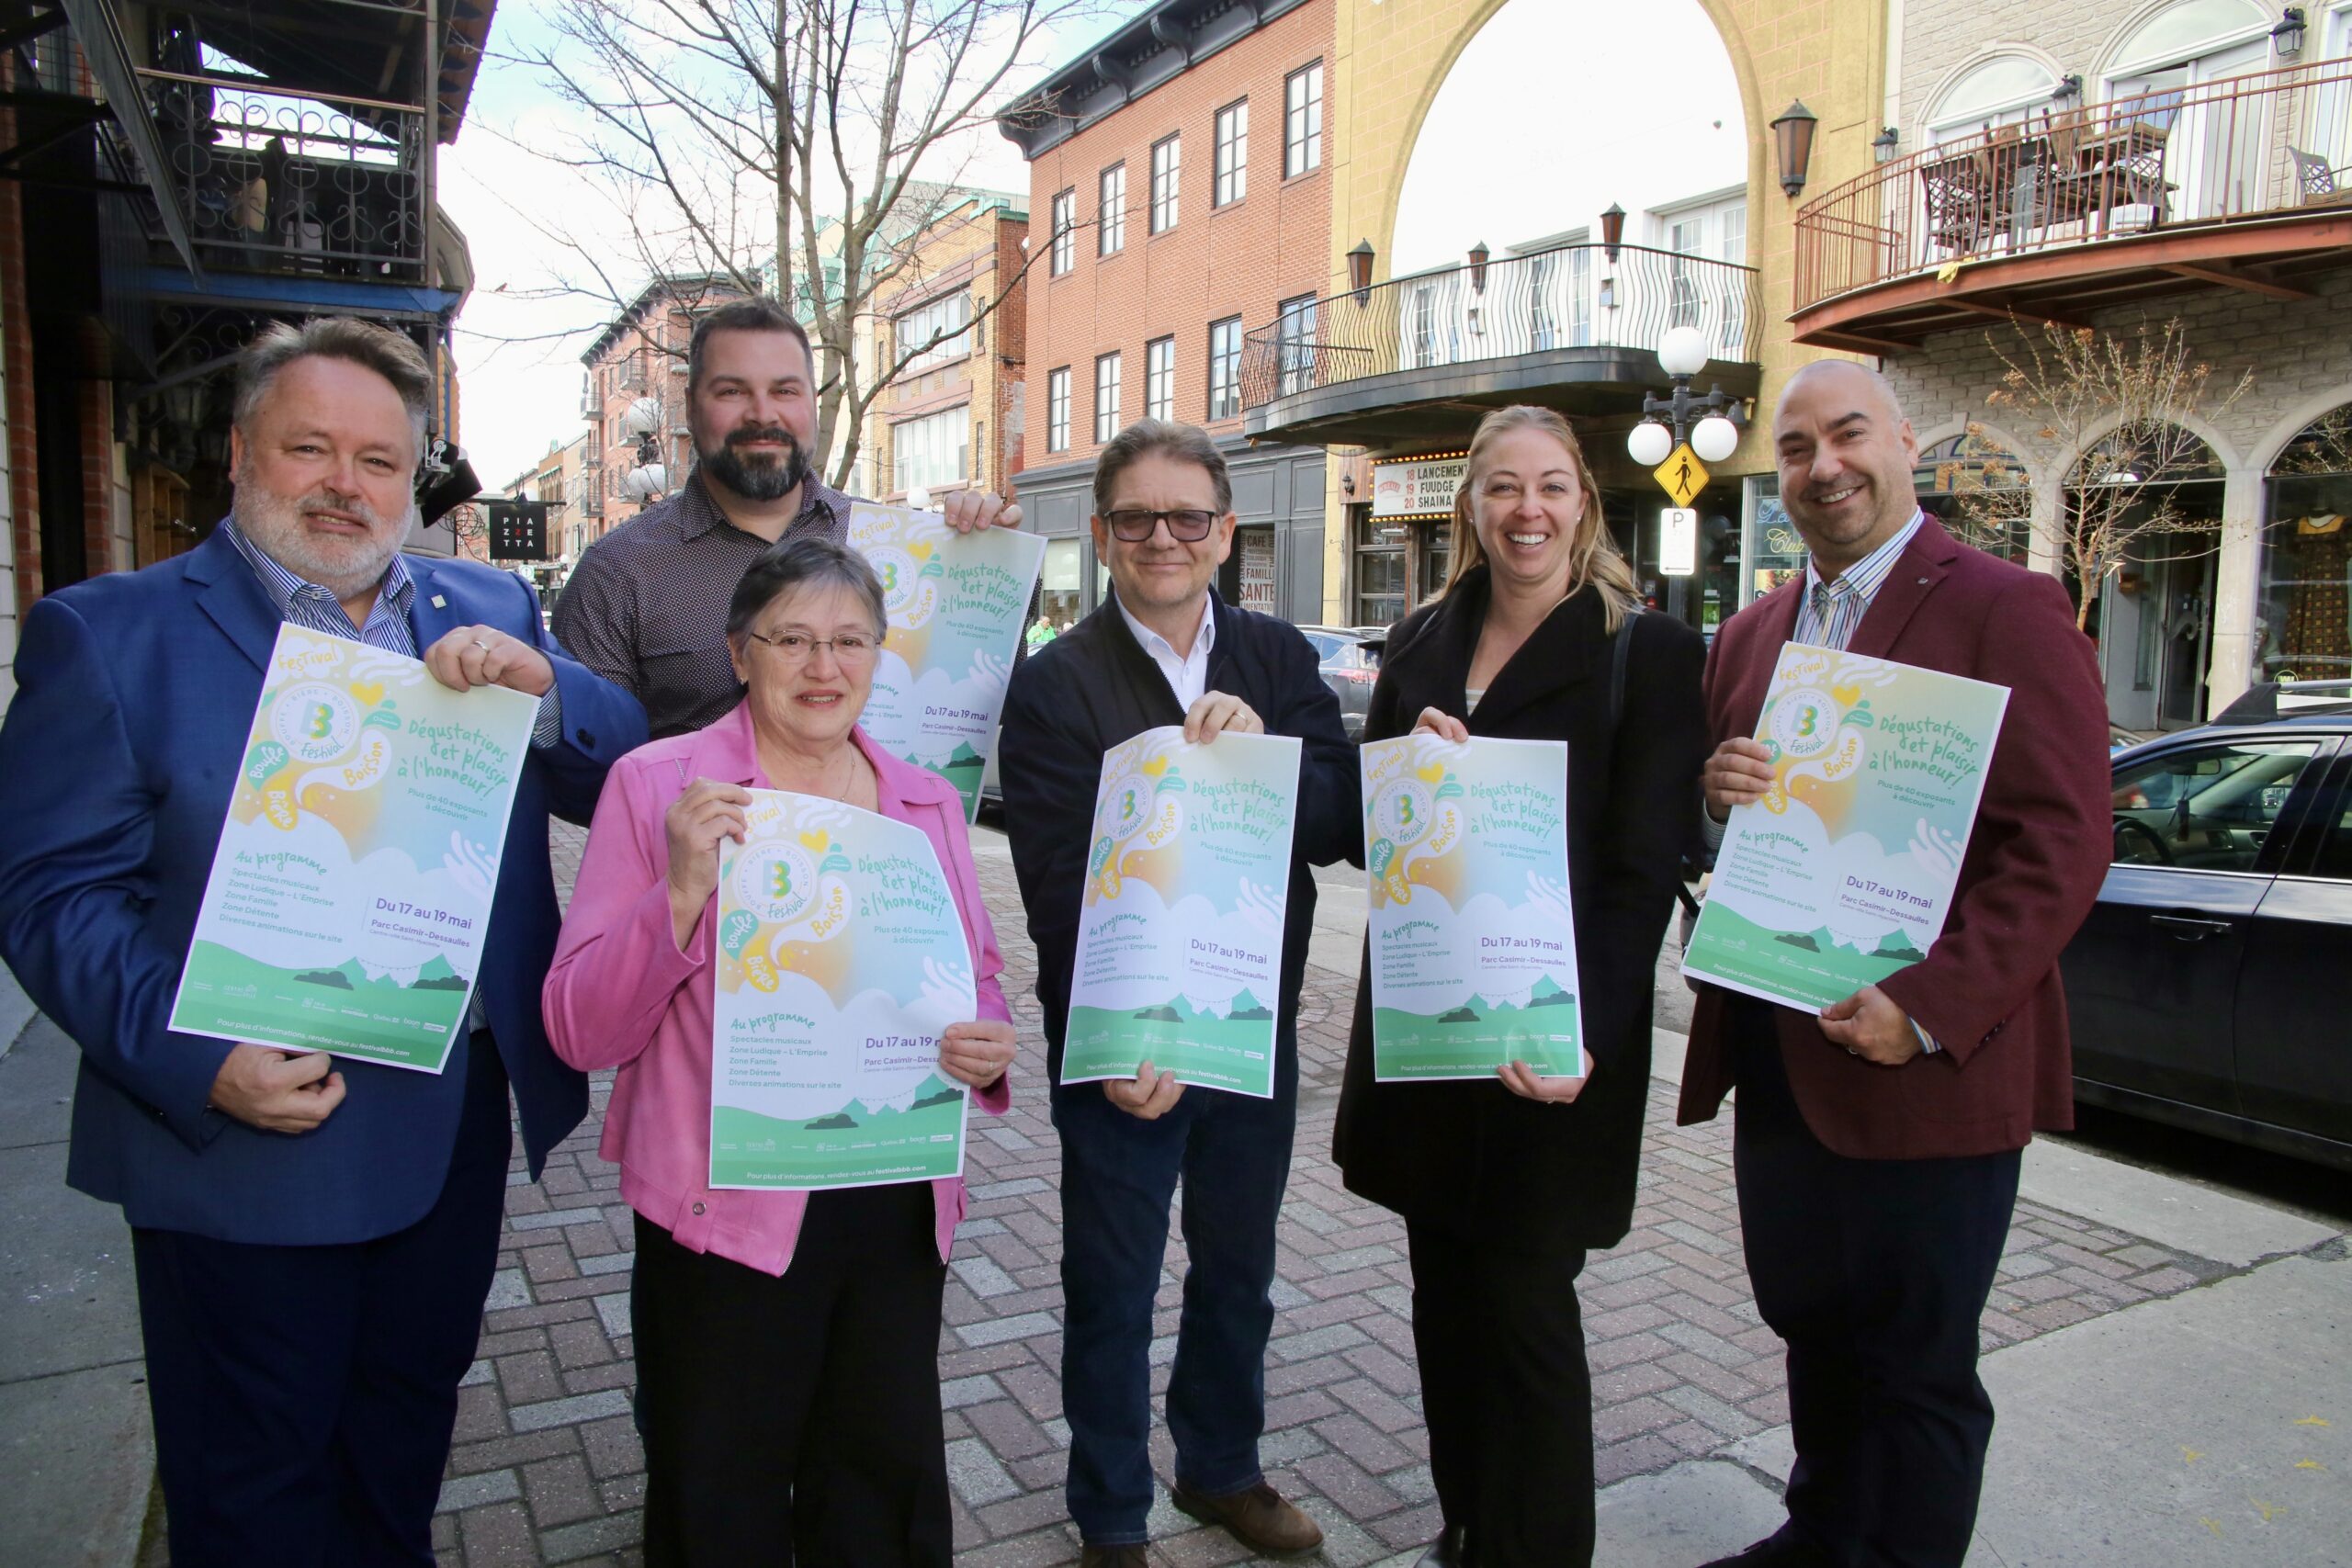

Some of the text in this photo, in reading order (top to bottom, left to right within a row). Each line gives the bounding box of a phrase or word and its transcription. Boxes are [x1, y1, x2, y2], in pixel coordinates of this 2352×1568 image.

[1407, 469, 1415, 480] 18
[1406, 484, 1414, 494] 19
[1420, 480, 1453, 493] FUUDGE
[1405, 495, 1452, 509] 20 SHAINA
[1672, 512, 1684, 528] P
[1763, 528, 1805, 553] Club
[948, 562, 1022, 592] Dégustations
[1246, 568, 1274, 580] FAMILL
[940, 598, 947, 613] à
[969, 580, 1021, 609] et plaisir
[925, 706, 989, 721] Du 17 au 19 mai
[408, 717, 509, 763] Dégustations
[1880, 715, 1979, 753] Dégustations
[343, 741, 382, 787] Boisson
[441, 744, 509, 785] et plaisir
[1823, 737, 1858, 778] Boisson
[1909, 737, 1978, 775] et plaisir
[398, 756, 494, 801] à l'honneur!
[1869, 750, 1963, 790] à l'honneur!
[407, 787, 488, 818] Plus de 40 exposants
[1193, 777, 1284, 812] Dégustations
[1471, 780, 1555, 811] Dégustations
[1877, 779, 1956, 806] Plus de 40 exposants
[1898, 794, 1936, 809] découvrir
[432, 804, 469, 821] découvrir
[1190, 816, 1198, 831] à
[1222, 797, 1288, 829] et plaisir
[1500, 798, 1561, 829] et plaisir
[1471, 818, 1479, 833] à
[1739, 829, 1809, 853] Au programme
[235, 851, 327, 875] Au programme
[858, 853, 937, 888] Dégustations
[228, 878, 250, 889] Zone
[891, 874, 948, 906] et plaisir
[1847, 875, 1933, 909] Du 17 au 19 mai
[221, 902, 243, 912] Zone
[225, 890, 278, 908] Zone Famille
[861, 897, 870, 917] à
[1841, 894, 1858, 905] Parc
[371, 919, 390, 930] Parc
[376, 897, 472, 930] Du 17 au 19 mai
[810, 886, 843, 939] Boisson
[1382, 920, 1441, 941] Au programme
[1191, 938, 1267, 964] Du 17 au 19 mai
[1481, 937, 1563, 951] Du 17 au 19 mai
[730, 1012, 816, 1033] Au programme
[865, 1038, 884, 1049] Du
[886, 1036, 899, 1047] 17
[900, 1038, 916, 1047] au
[919, 1036, 933, 1046] 19
[865, 1058, 882, 1066] Parc
